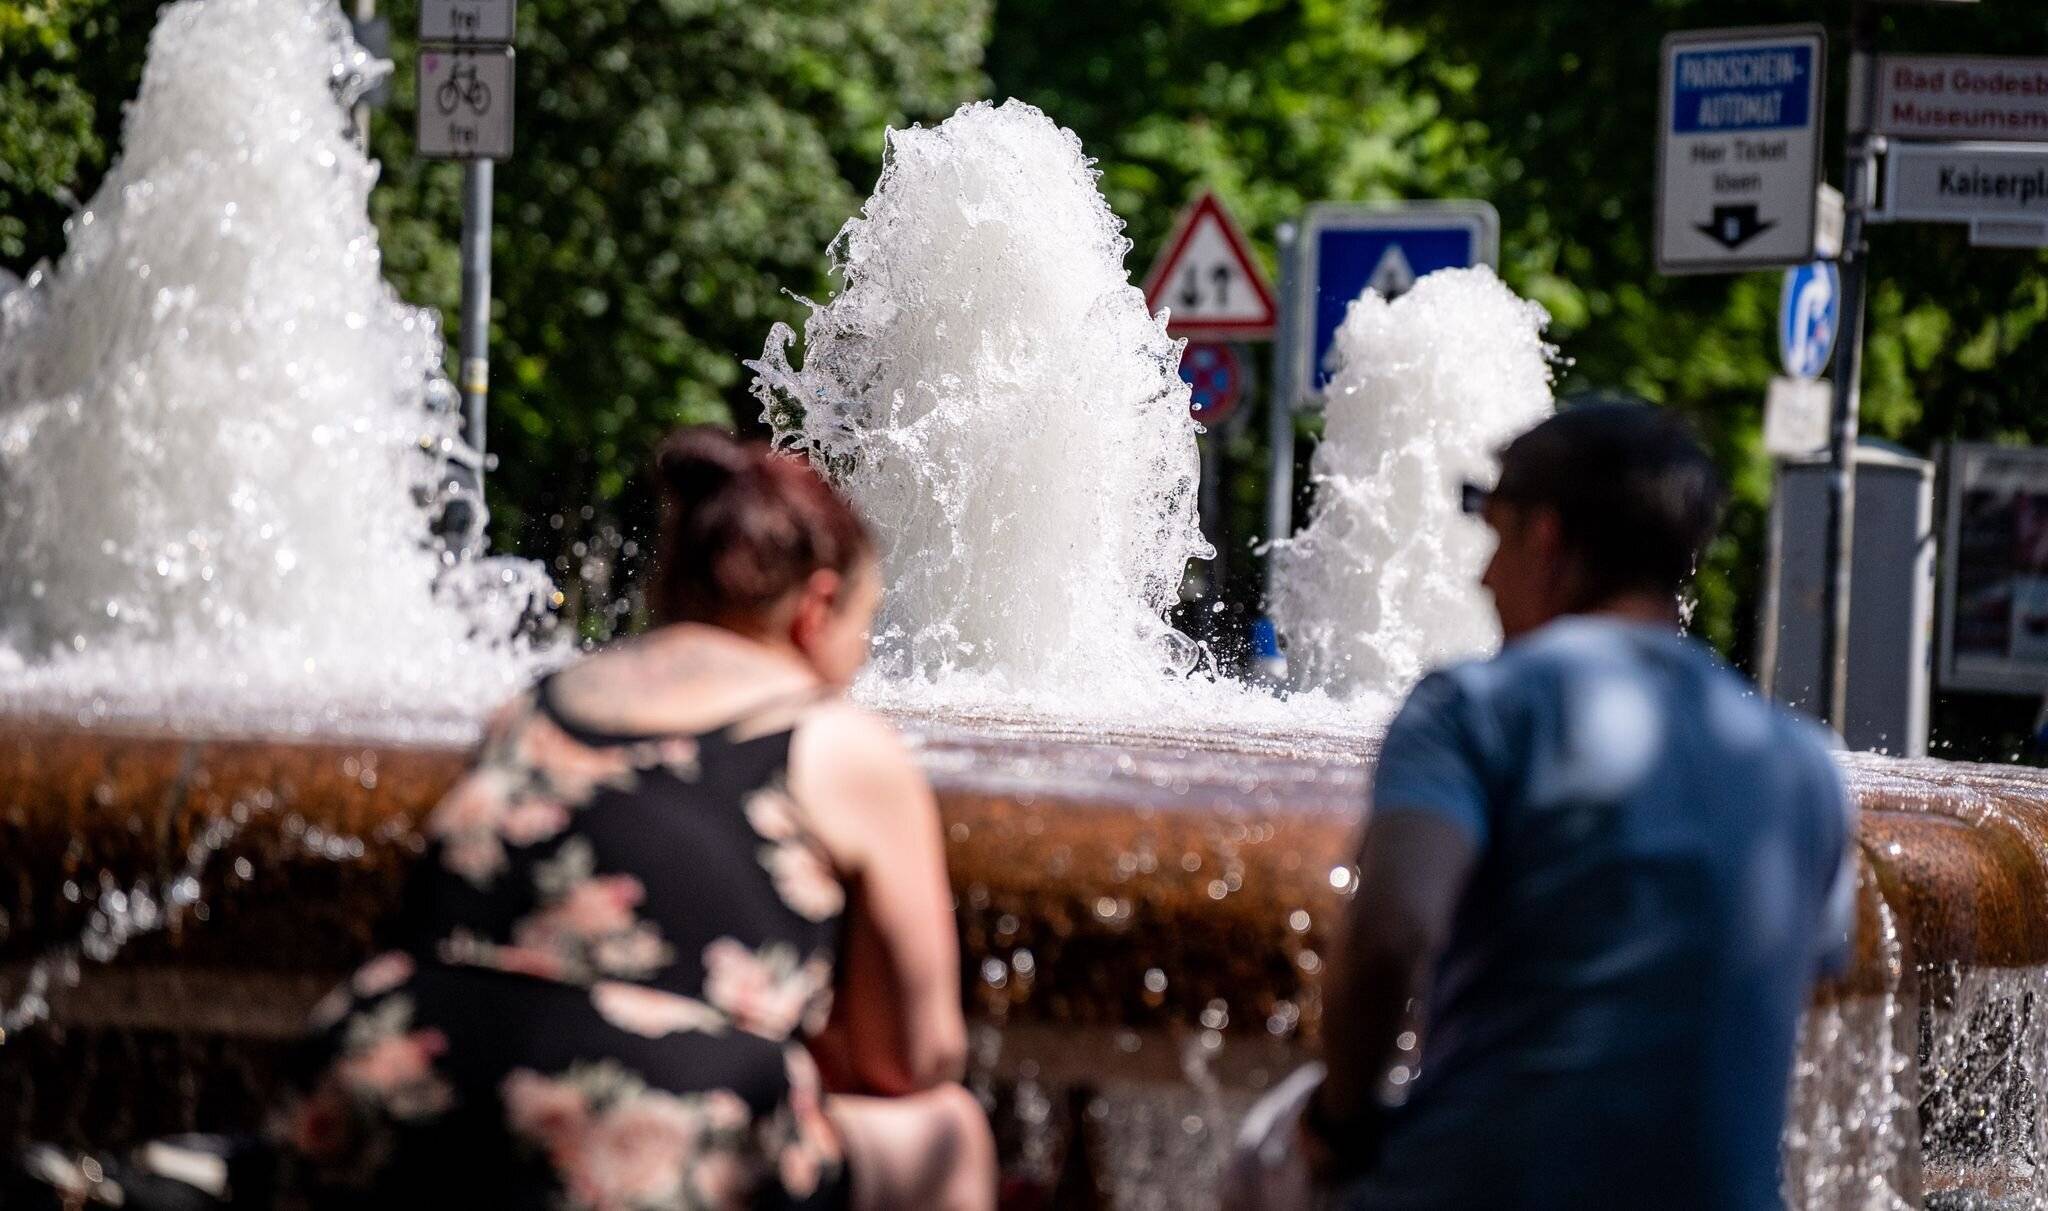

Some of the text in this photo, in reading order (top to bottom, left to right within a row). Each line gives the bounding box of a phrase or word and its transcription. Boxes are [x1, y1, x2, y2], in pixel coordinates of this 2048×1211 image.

[450, 5, 481, 29] frei
[1681, 53, 1804, 88] PARKSCHEIN-
[1893, 65, 1945, 91] Bad
[1697, 90, 1783, 127] AUTOMAT
[448, 121, 479, 143] frei
[1689, 138, 1788, 163] Hier Ticket
